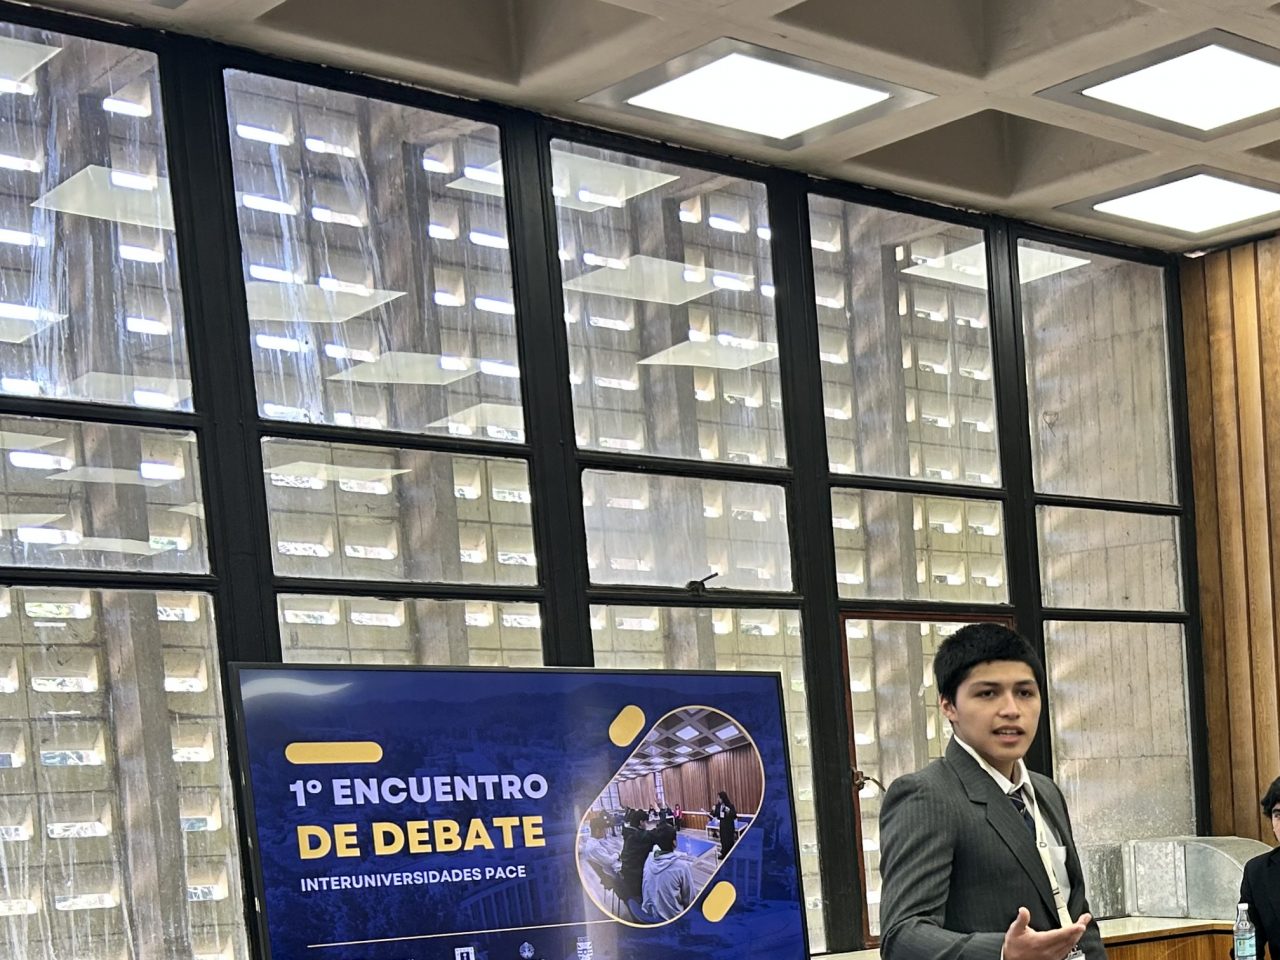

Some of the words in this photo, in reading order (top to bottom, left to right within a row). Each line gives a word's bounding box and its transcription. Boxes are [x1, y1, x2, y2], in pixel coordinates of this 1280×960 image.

[332, 773, 549, 806] ENCUENTRO
[297, 823, 361, 860] DE
[372, 815, 546, 856] DEBATE
[300, 870, 482, 892] INTERUNIVERSIDADES
[486, 865, 527, 880] PACE
